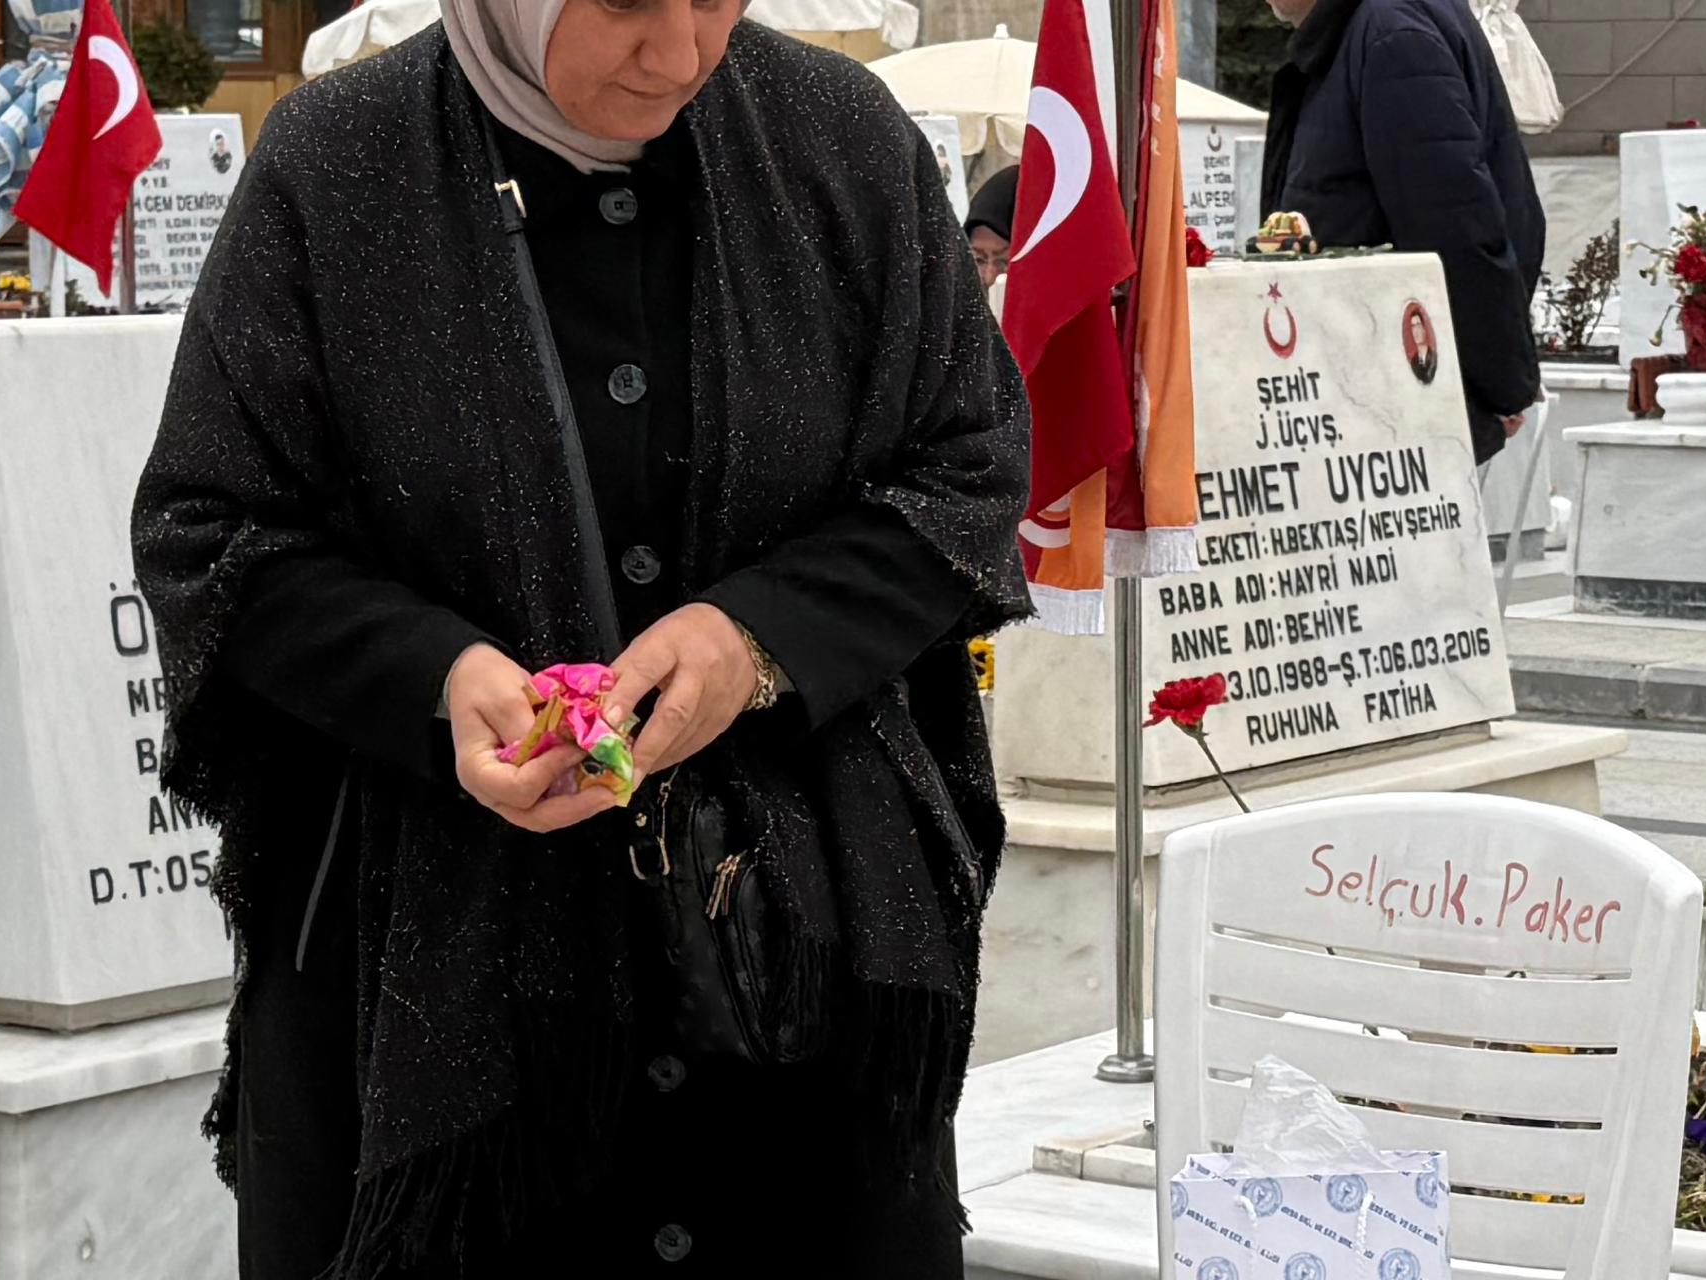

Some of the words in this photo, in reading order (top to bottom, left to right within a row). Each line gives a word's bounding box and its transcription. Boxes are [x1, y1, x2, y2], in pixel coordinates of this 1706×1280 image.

[1256, 366, 1321, 411] ŞEHİT
[1194, 462, 1300, 521] EHMET
[1325, 446, 1430, 505] UYGUN
[1159, 581, 1223, 616] BABA
[1348, 546, 1398, 586] NADİ
[1171, 624, 1232, 664] ANNE
[1247, 701, 1340, 747] RUHUNA
[1364, 678, 1437, 724] FATİHA
[1497, 862, 1622, 944] Paker
